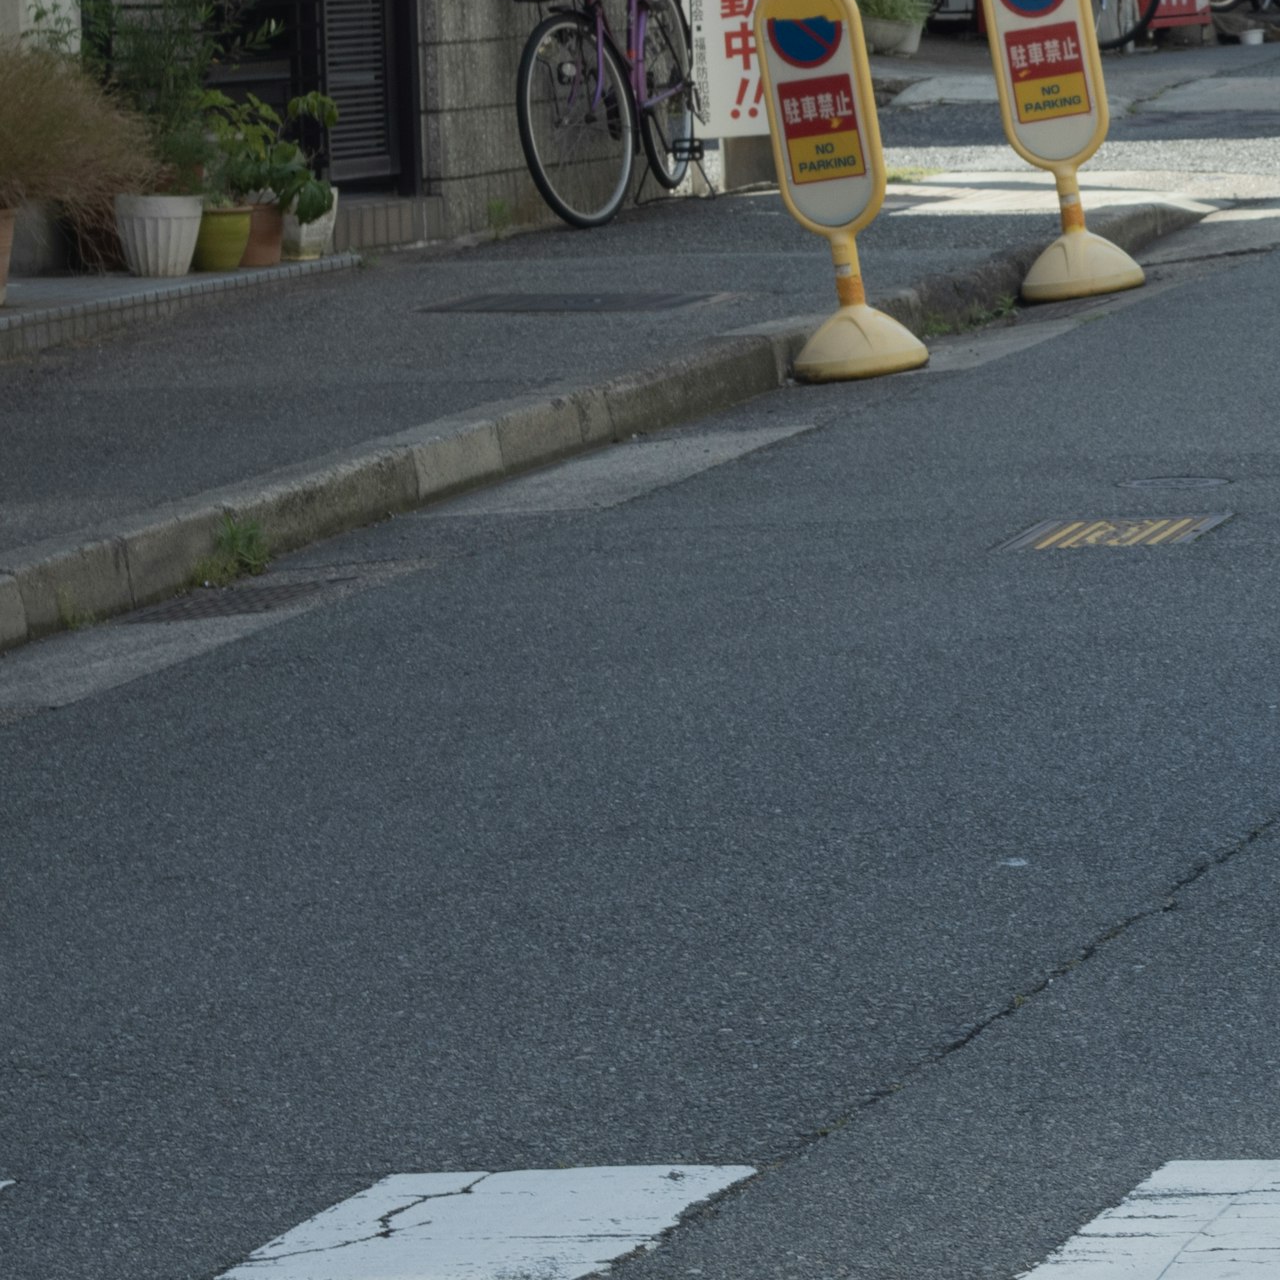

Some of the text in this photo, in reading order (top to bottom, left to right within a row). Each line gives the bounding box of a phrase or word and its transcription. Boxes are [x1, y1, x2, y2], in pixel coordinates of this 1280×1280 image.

[1010, 36, 1079, 69] 駐車禁止
[1041, 84, 1061, 96] NO
[782, 90, 853, 125] 駐車禁止
[1024, 95, 1082, 114] PARKING
[815, 143, 835, 155] NO
[798, 155, 857, 173] PARKING
